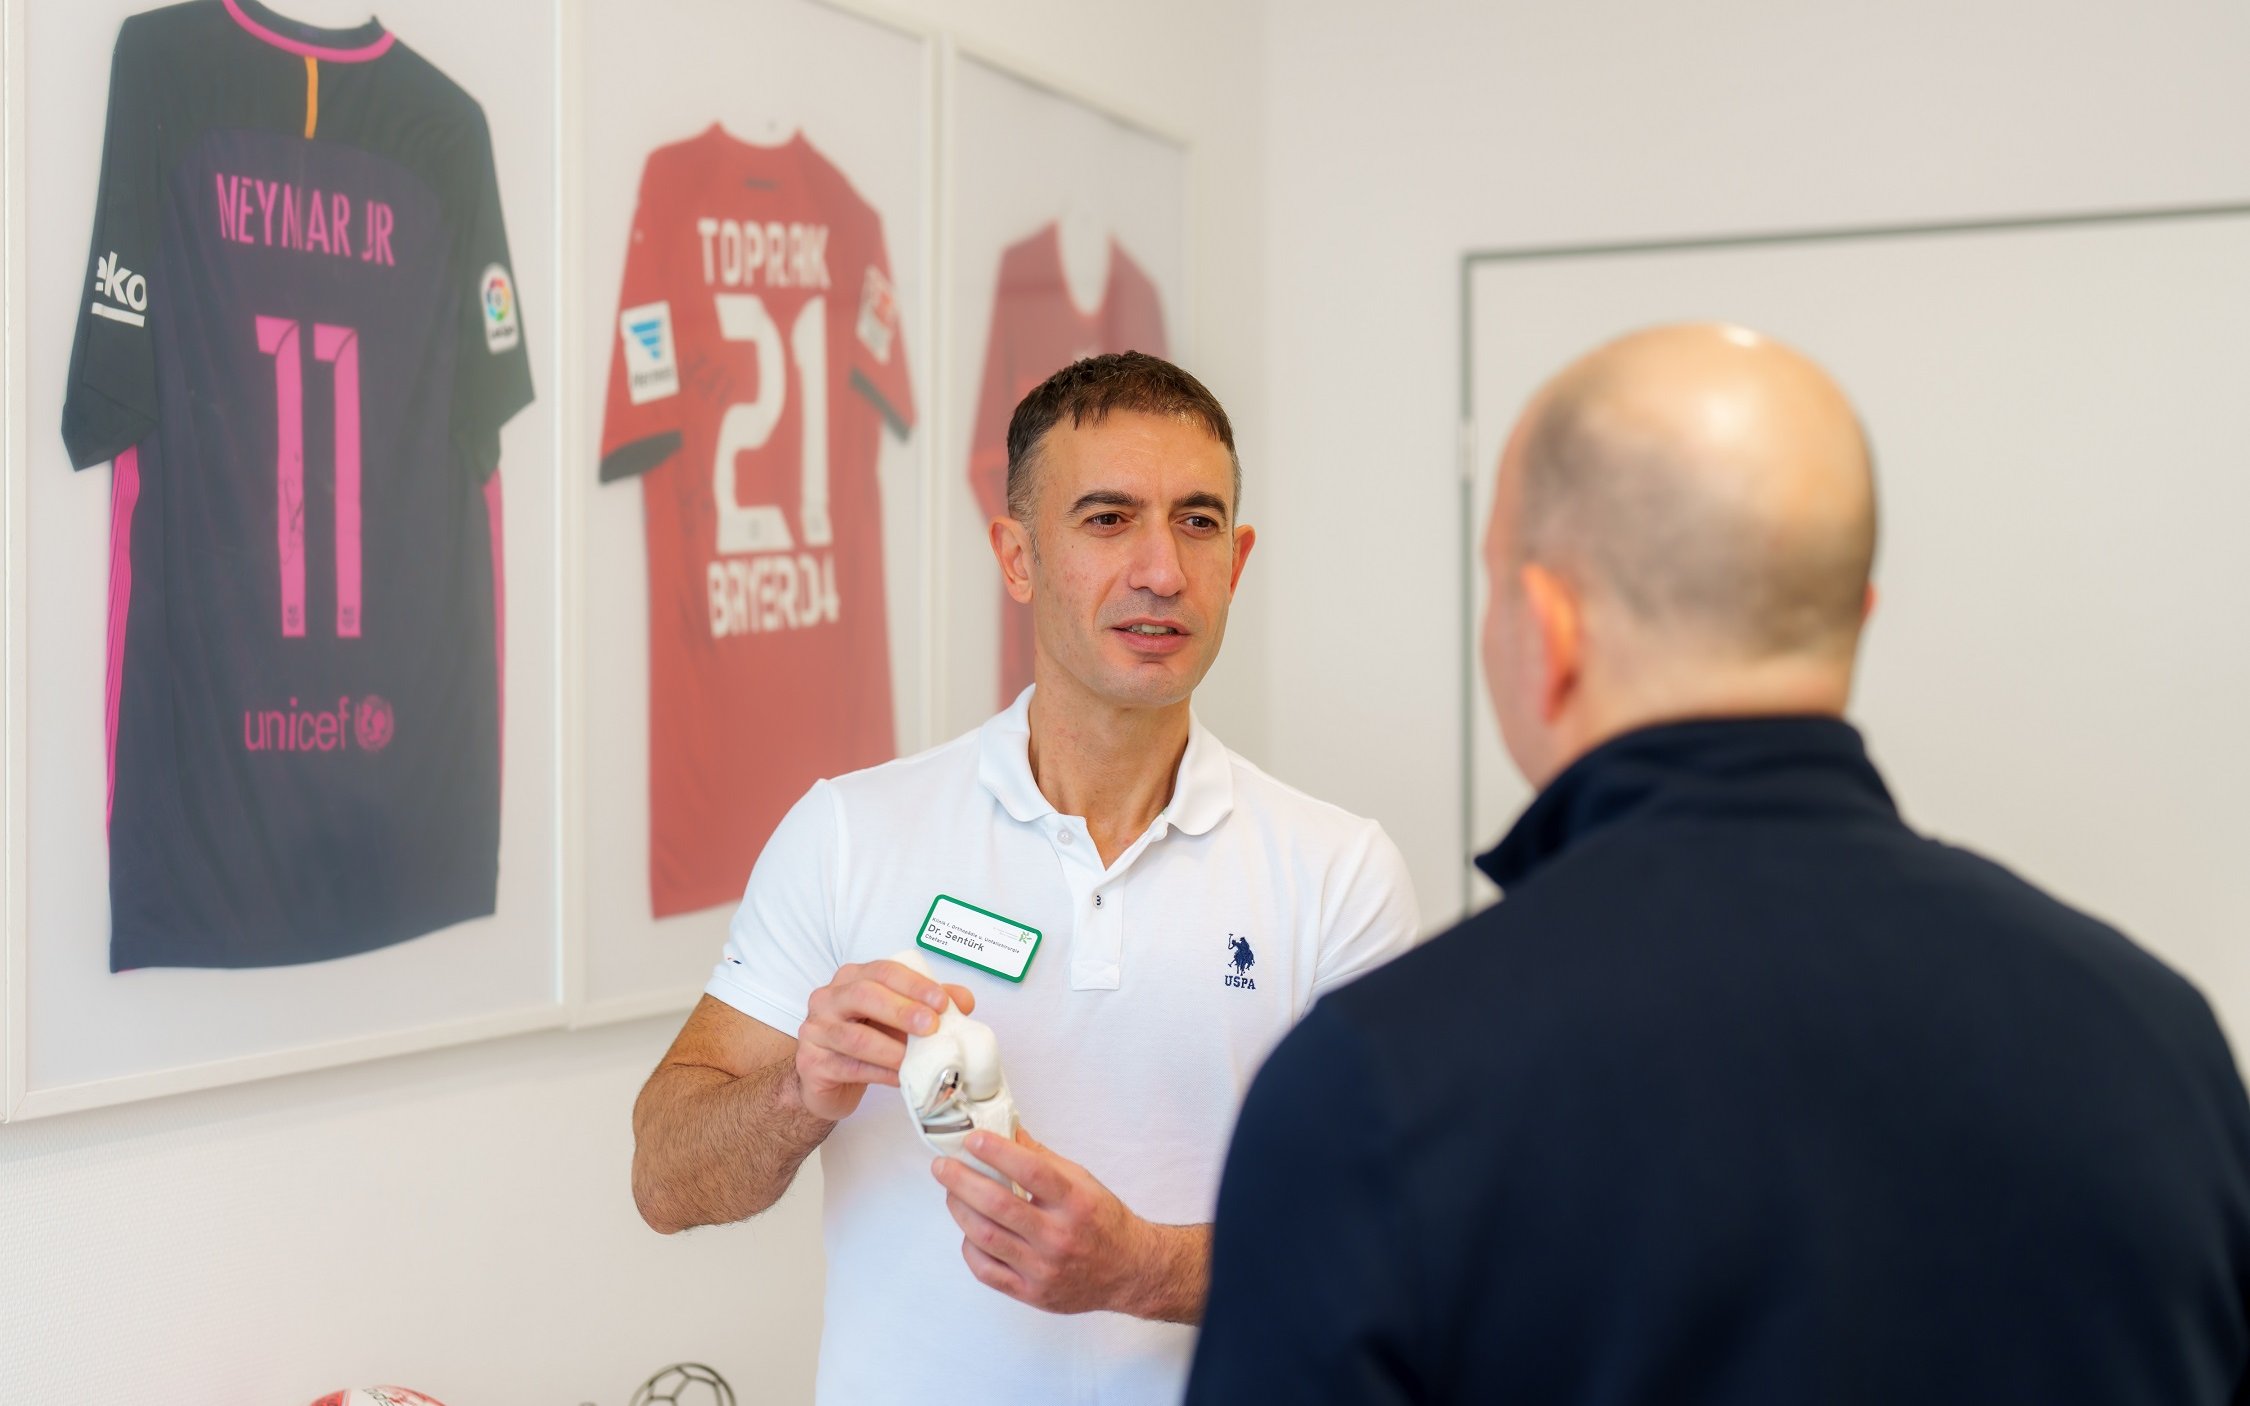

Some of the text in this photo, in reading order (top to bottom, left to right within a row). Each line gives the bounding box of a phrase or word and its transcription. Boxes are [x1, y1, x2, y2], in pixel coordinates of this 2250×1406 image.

[216, 173, 395, 267] NEYMAR JR
[697, 217, 831, 290] TOPRAK
[712, 293, 833, 555] 21
[255, 314, 361, 637] 11
[245, 696, 350, 751] unicef
[927, 923, 942, 936] Dr.
[945, 930, 985, 952] Sentürk
[1224, 975, 1256, 990] USPA
